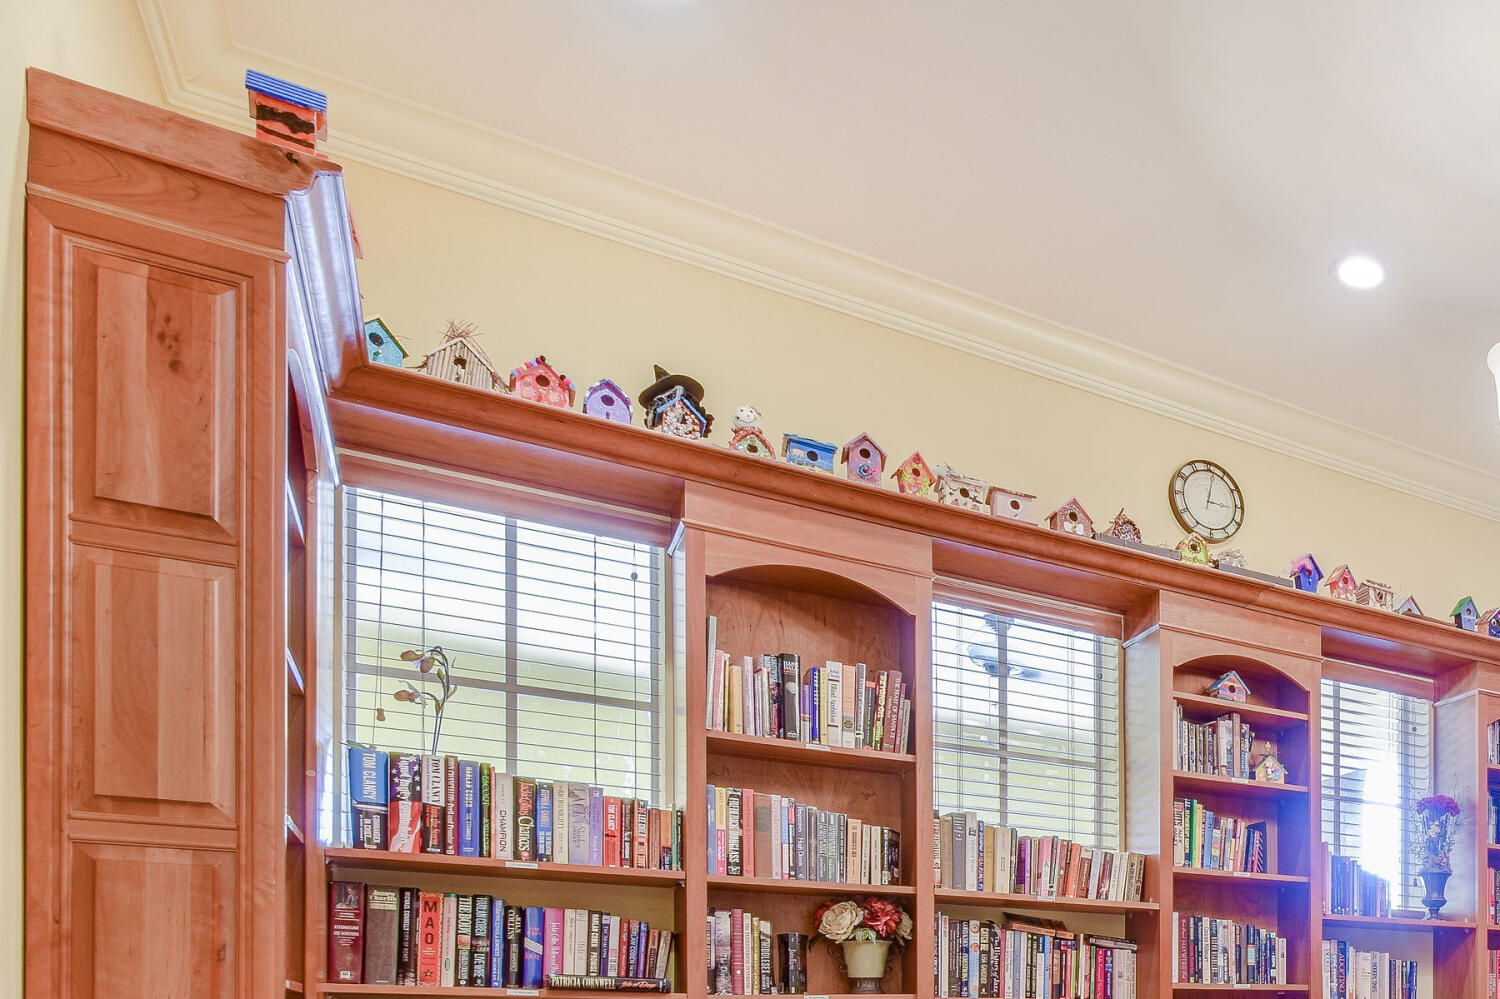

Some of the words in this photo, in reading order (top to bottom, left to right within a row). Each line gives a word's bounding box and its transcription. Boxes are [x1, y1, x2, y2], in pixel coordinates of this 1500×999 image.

[830, 684, 838, 699] Blind
[363, 753, 376, 768] TOM
[399, 756, 411, 775] Tom
[432, 758, 440, 773] TOM
[363, 771, 376, 799] CLANCY
[396, 775, 412, 800] Clancy
[432, 775, 440, 804] CLANCY
[518, 782, 534, 799] Jackie
[729, 797, 740, 829] FREDERICK
[518, 816, 536, 851] Chances
[729, 832, 740, 862] DOUGLASS
[458, 898, 471, 913] THE
[476, 898, 488, 918] HARLAN
[424, 901, 437, 944] MAO
[458, 914, 471, 935] BODY
[475, 918, 488, 936] COBEN
[474, 954, 485, 964] LIVE
[761, 942, 770, 973] MIDDLESEX
[474, 965, 485, 977] WIRE
[550, 977, 580, 988] PATRICIA
[582, 977, 615, 989] CORNWELL
